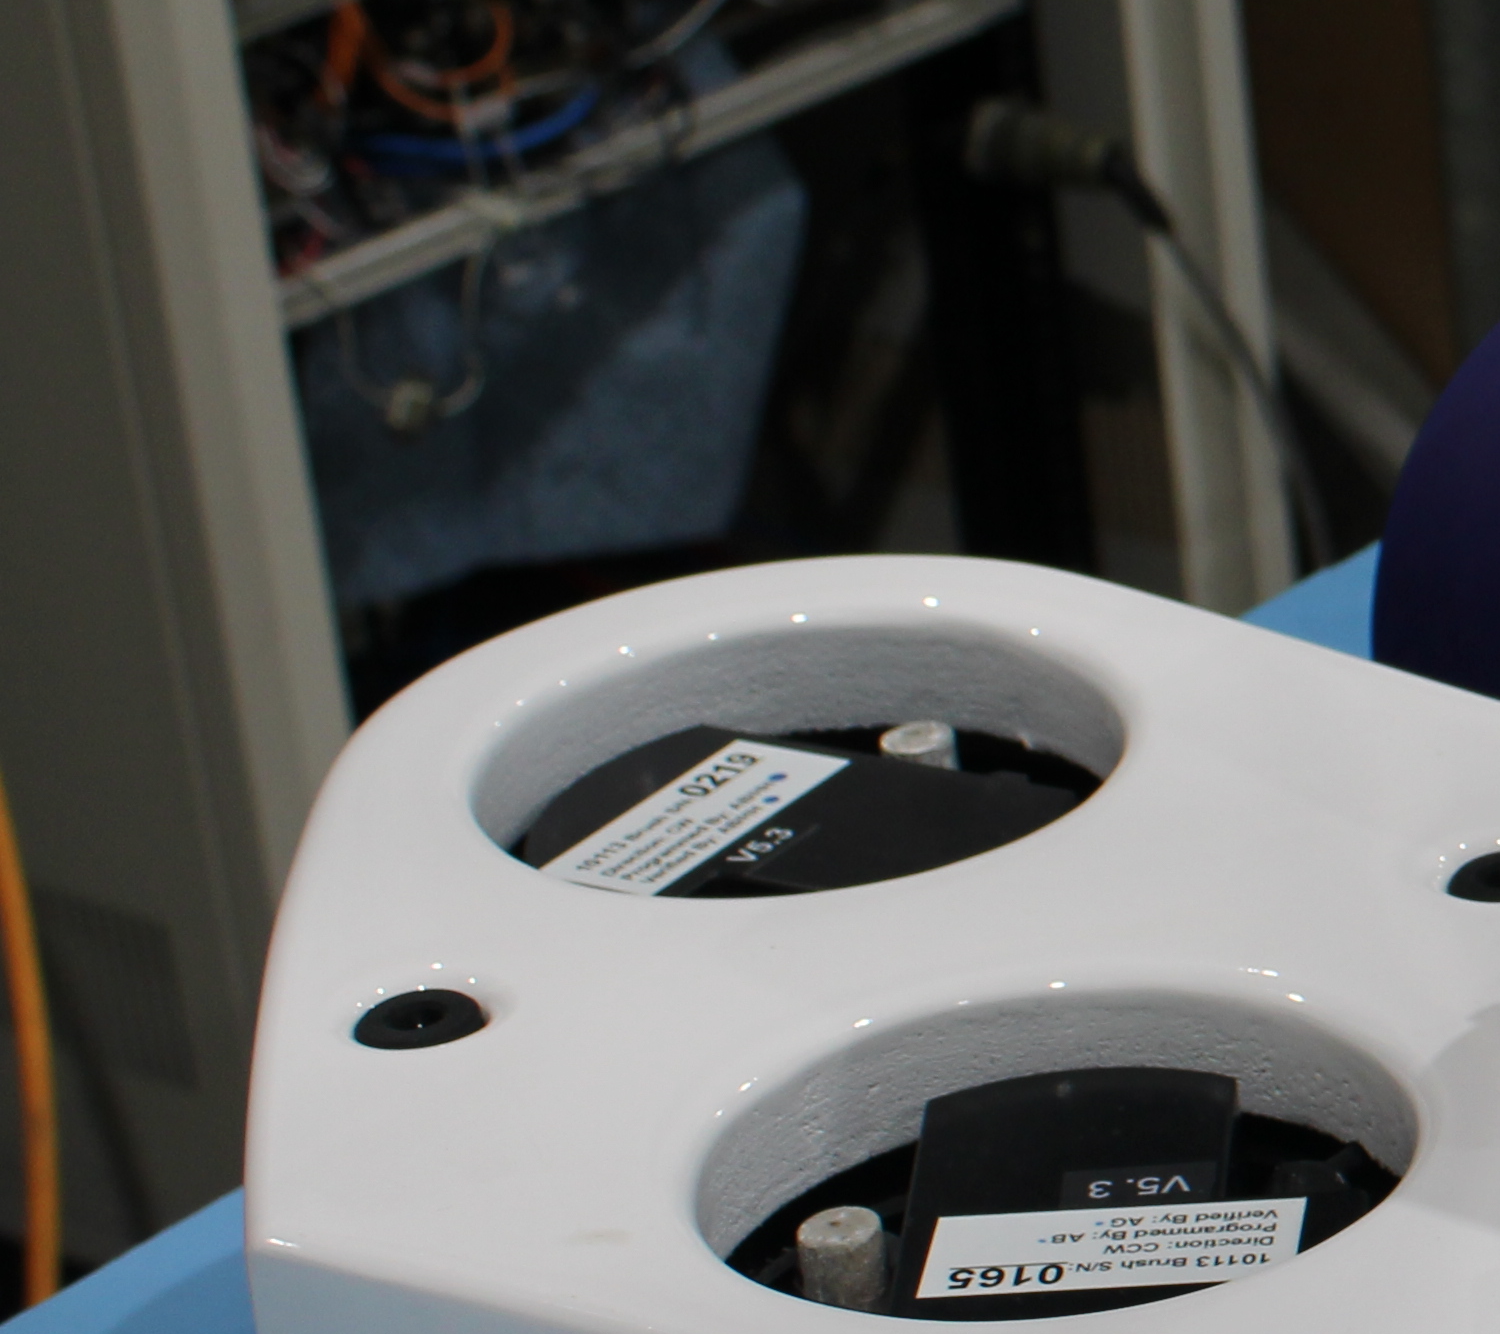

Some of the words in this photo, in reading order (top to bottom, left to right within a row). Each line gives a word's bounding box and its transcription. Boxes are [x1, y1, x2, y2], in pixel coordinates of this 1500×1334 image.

[575, 840, 628, 872] 10113
[678, 753, 759, 797] 0219
[1110, 1216, 1145, 1228] AG
[1151, 1212, 1188, 1225] By:
[1195, 1208, 1279, 1223] Verified
[1051, 1231, 1085, 1244] AB
[1092, 1227, 1127, 1240] By:
[1133, 1222, 1277, 1239] Programmed
[1102, 1241, 1159, 1254] CCW
[1166, 1235, 1275, 1250] Direction:
[1068, 1259, 1111, 1273] S/N:
[1122, 1256, 1188, 1270] Brush
[1197, 1252, 1271, 1268] 10113
[948, 1266, 1063, 1291] 0165
